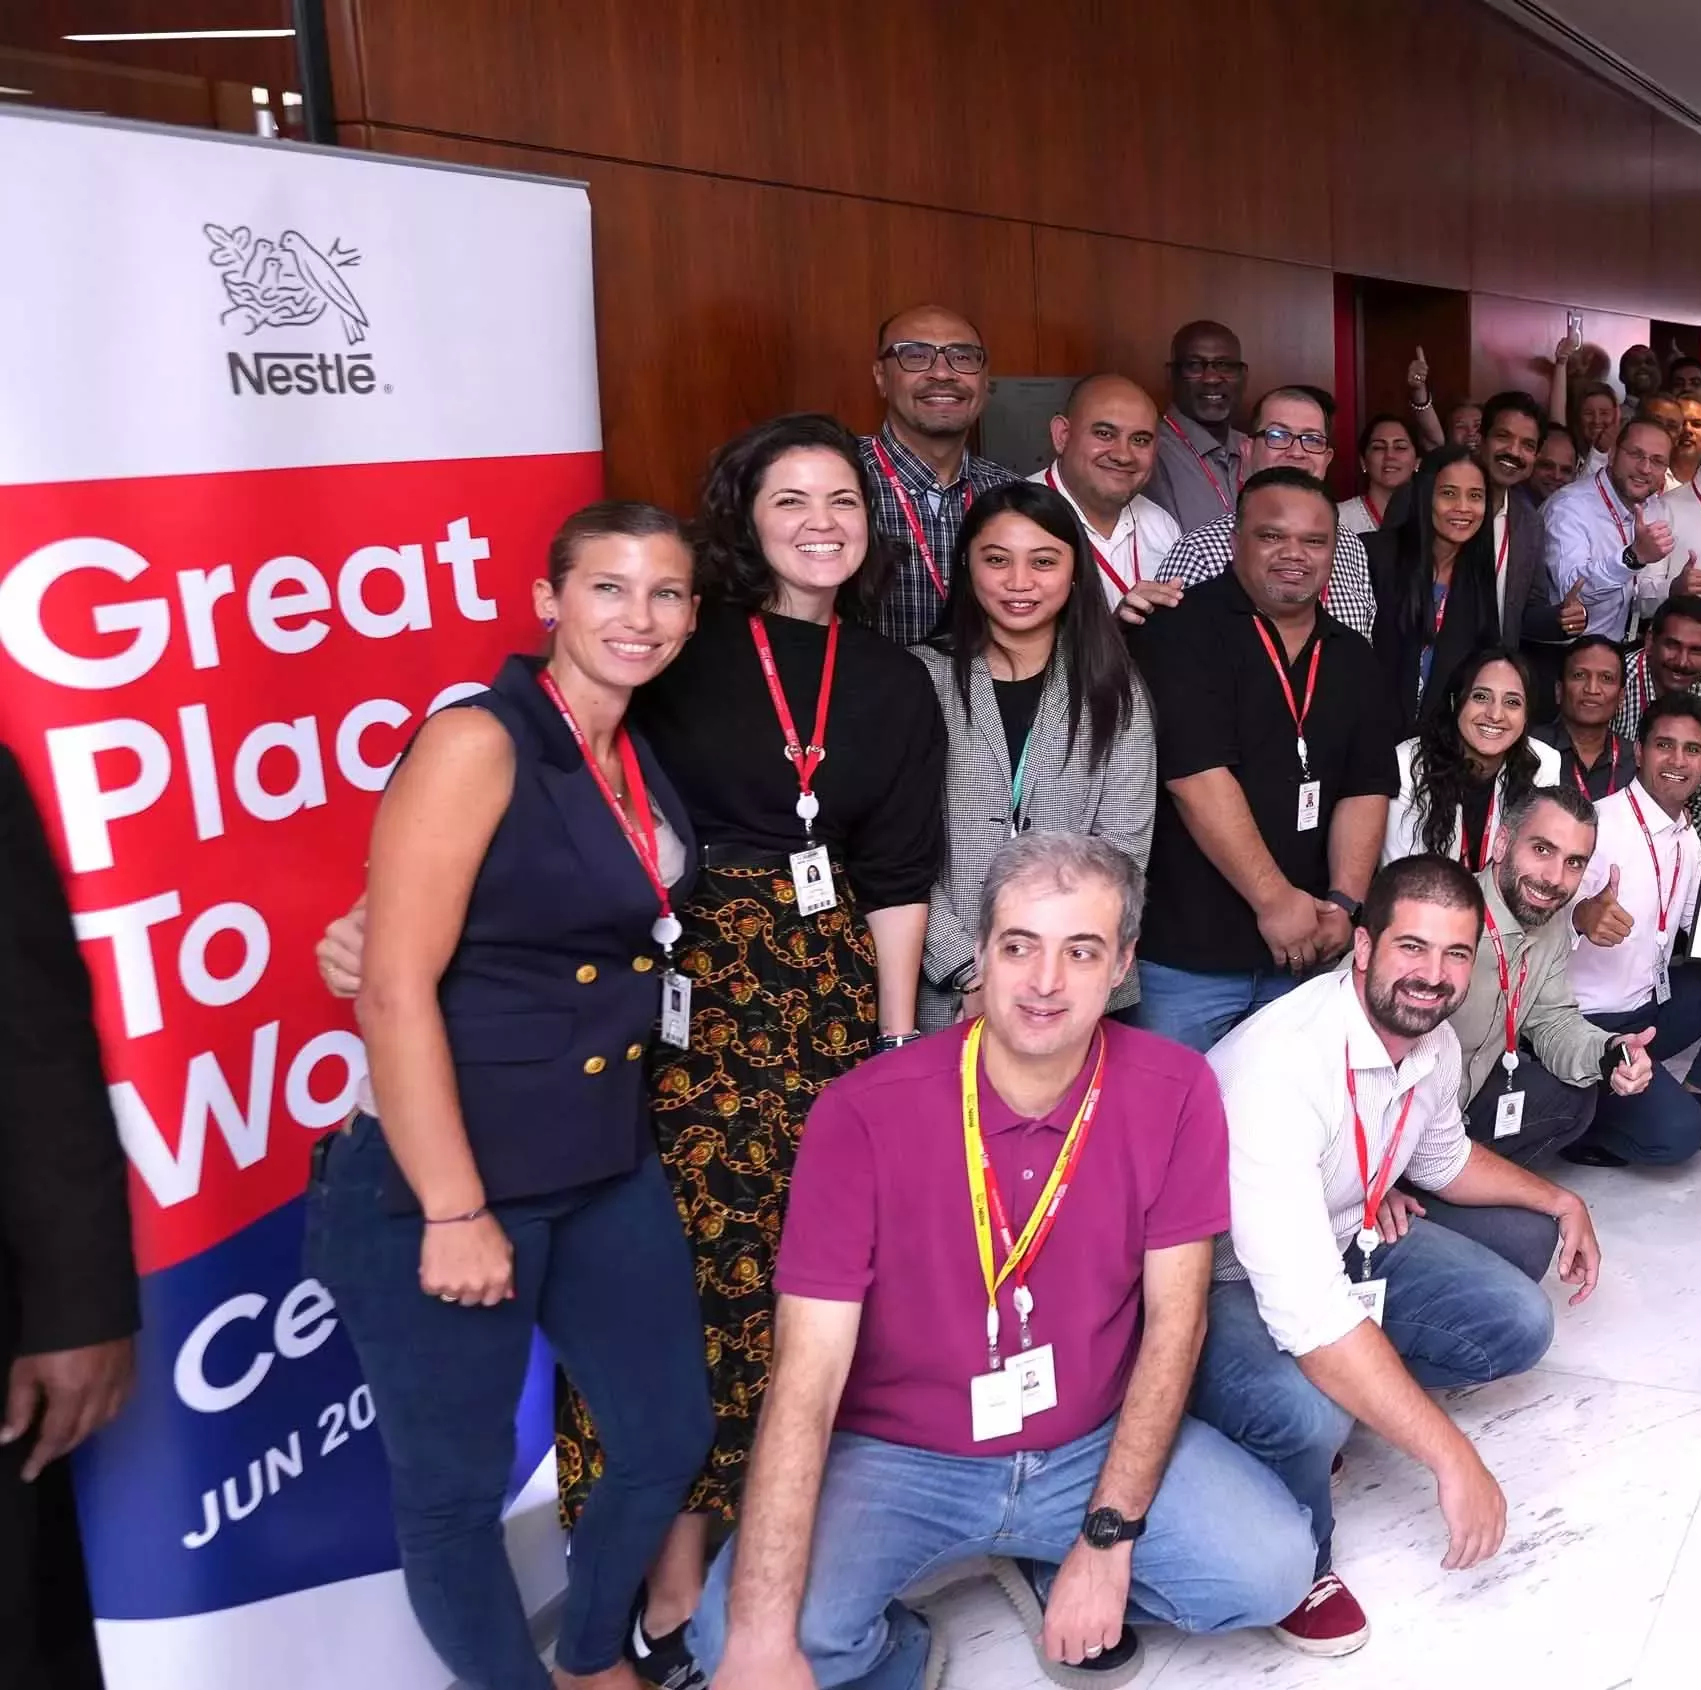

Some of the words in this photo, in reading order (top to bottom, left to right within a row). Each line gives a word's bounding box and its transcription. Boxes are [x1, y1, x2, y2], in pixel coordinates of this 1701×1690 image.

[0, 516, 498, 690] Great
[45, 682, 491, 874] Plac
[71, 890, 271, 1040] To
[181, 1431, 304, 1550] JUN
